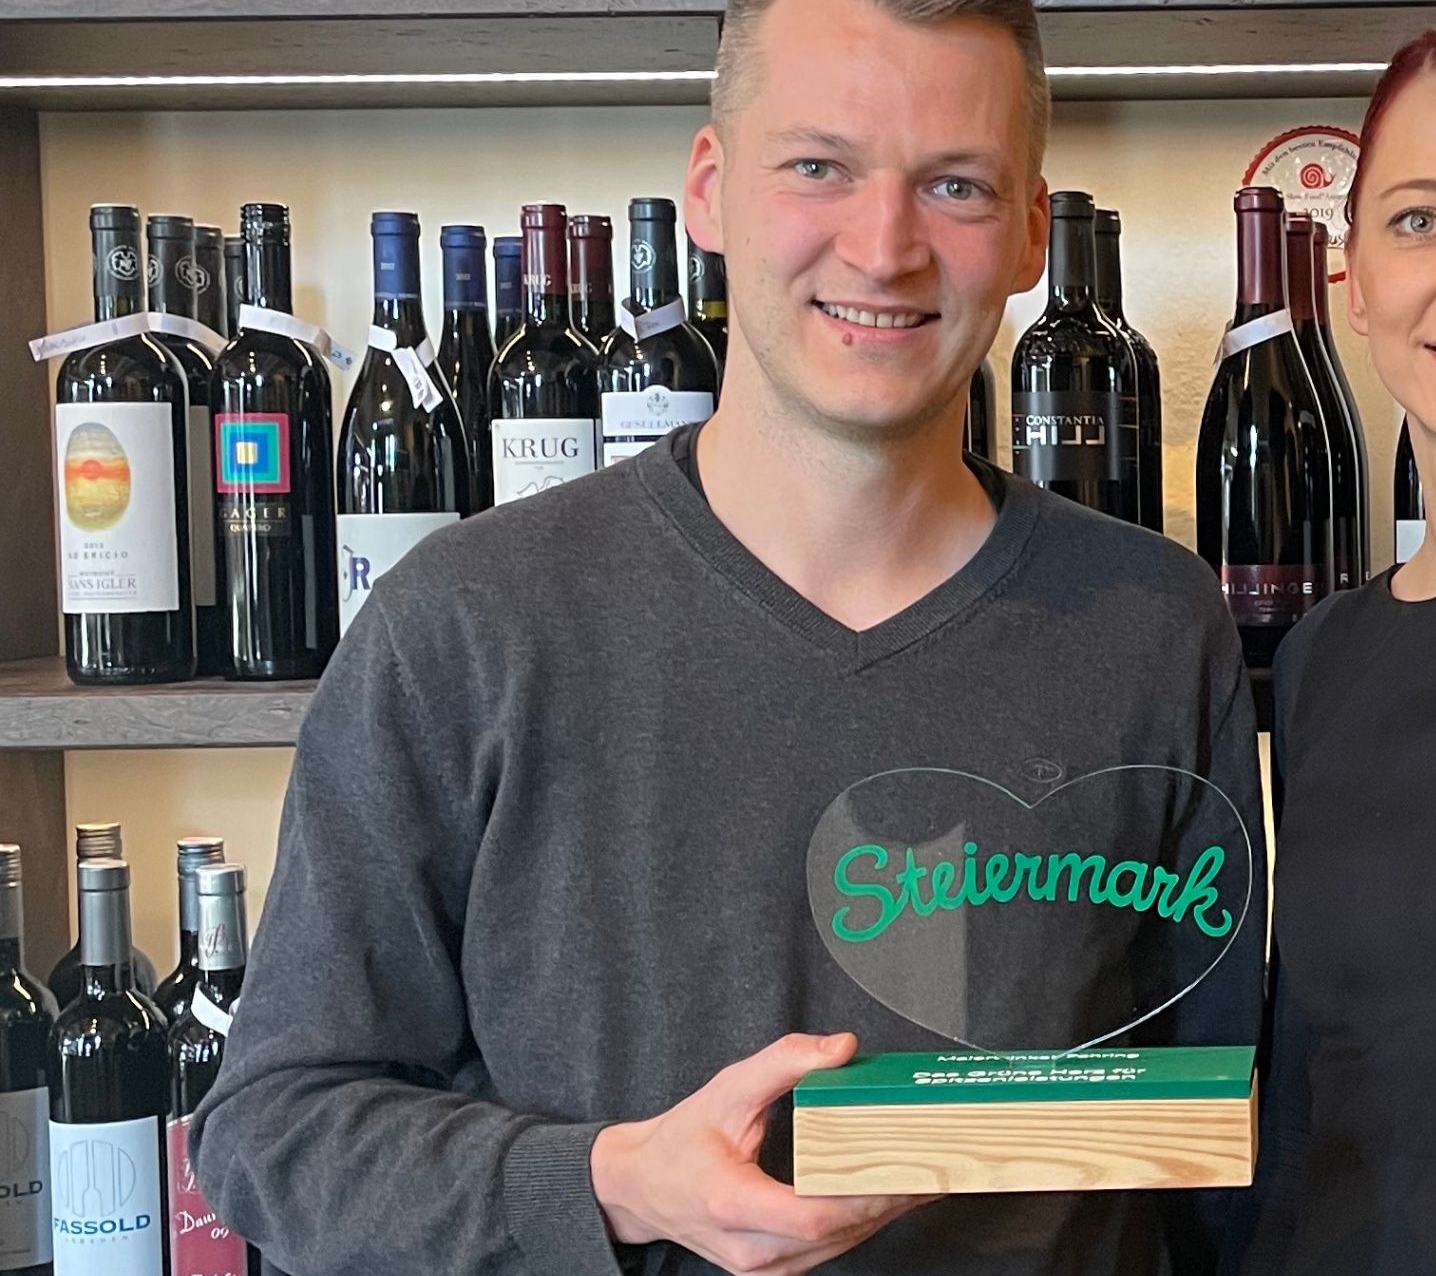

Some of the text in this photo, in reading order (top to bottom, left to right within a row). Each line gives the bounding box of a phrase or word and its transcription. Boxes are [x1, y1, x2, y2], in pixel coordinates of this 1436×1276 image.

[1026, 415, 1104, 425] CONSTANTIA
[503, 437, 579, 459] KRUG
[230, 524, 271, 532] QUARO
[97, 577, 136, 590] IGLER
[832, 842, 1233, 943] Steiermark
[54, 1214, 151, 1235] FASSOLD
